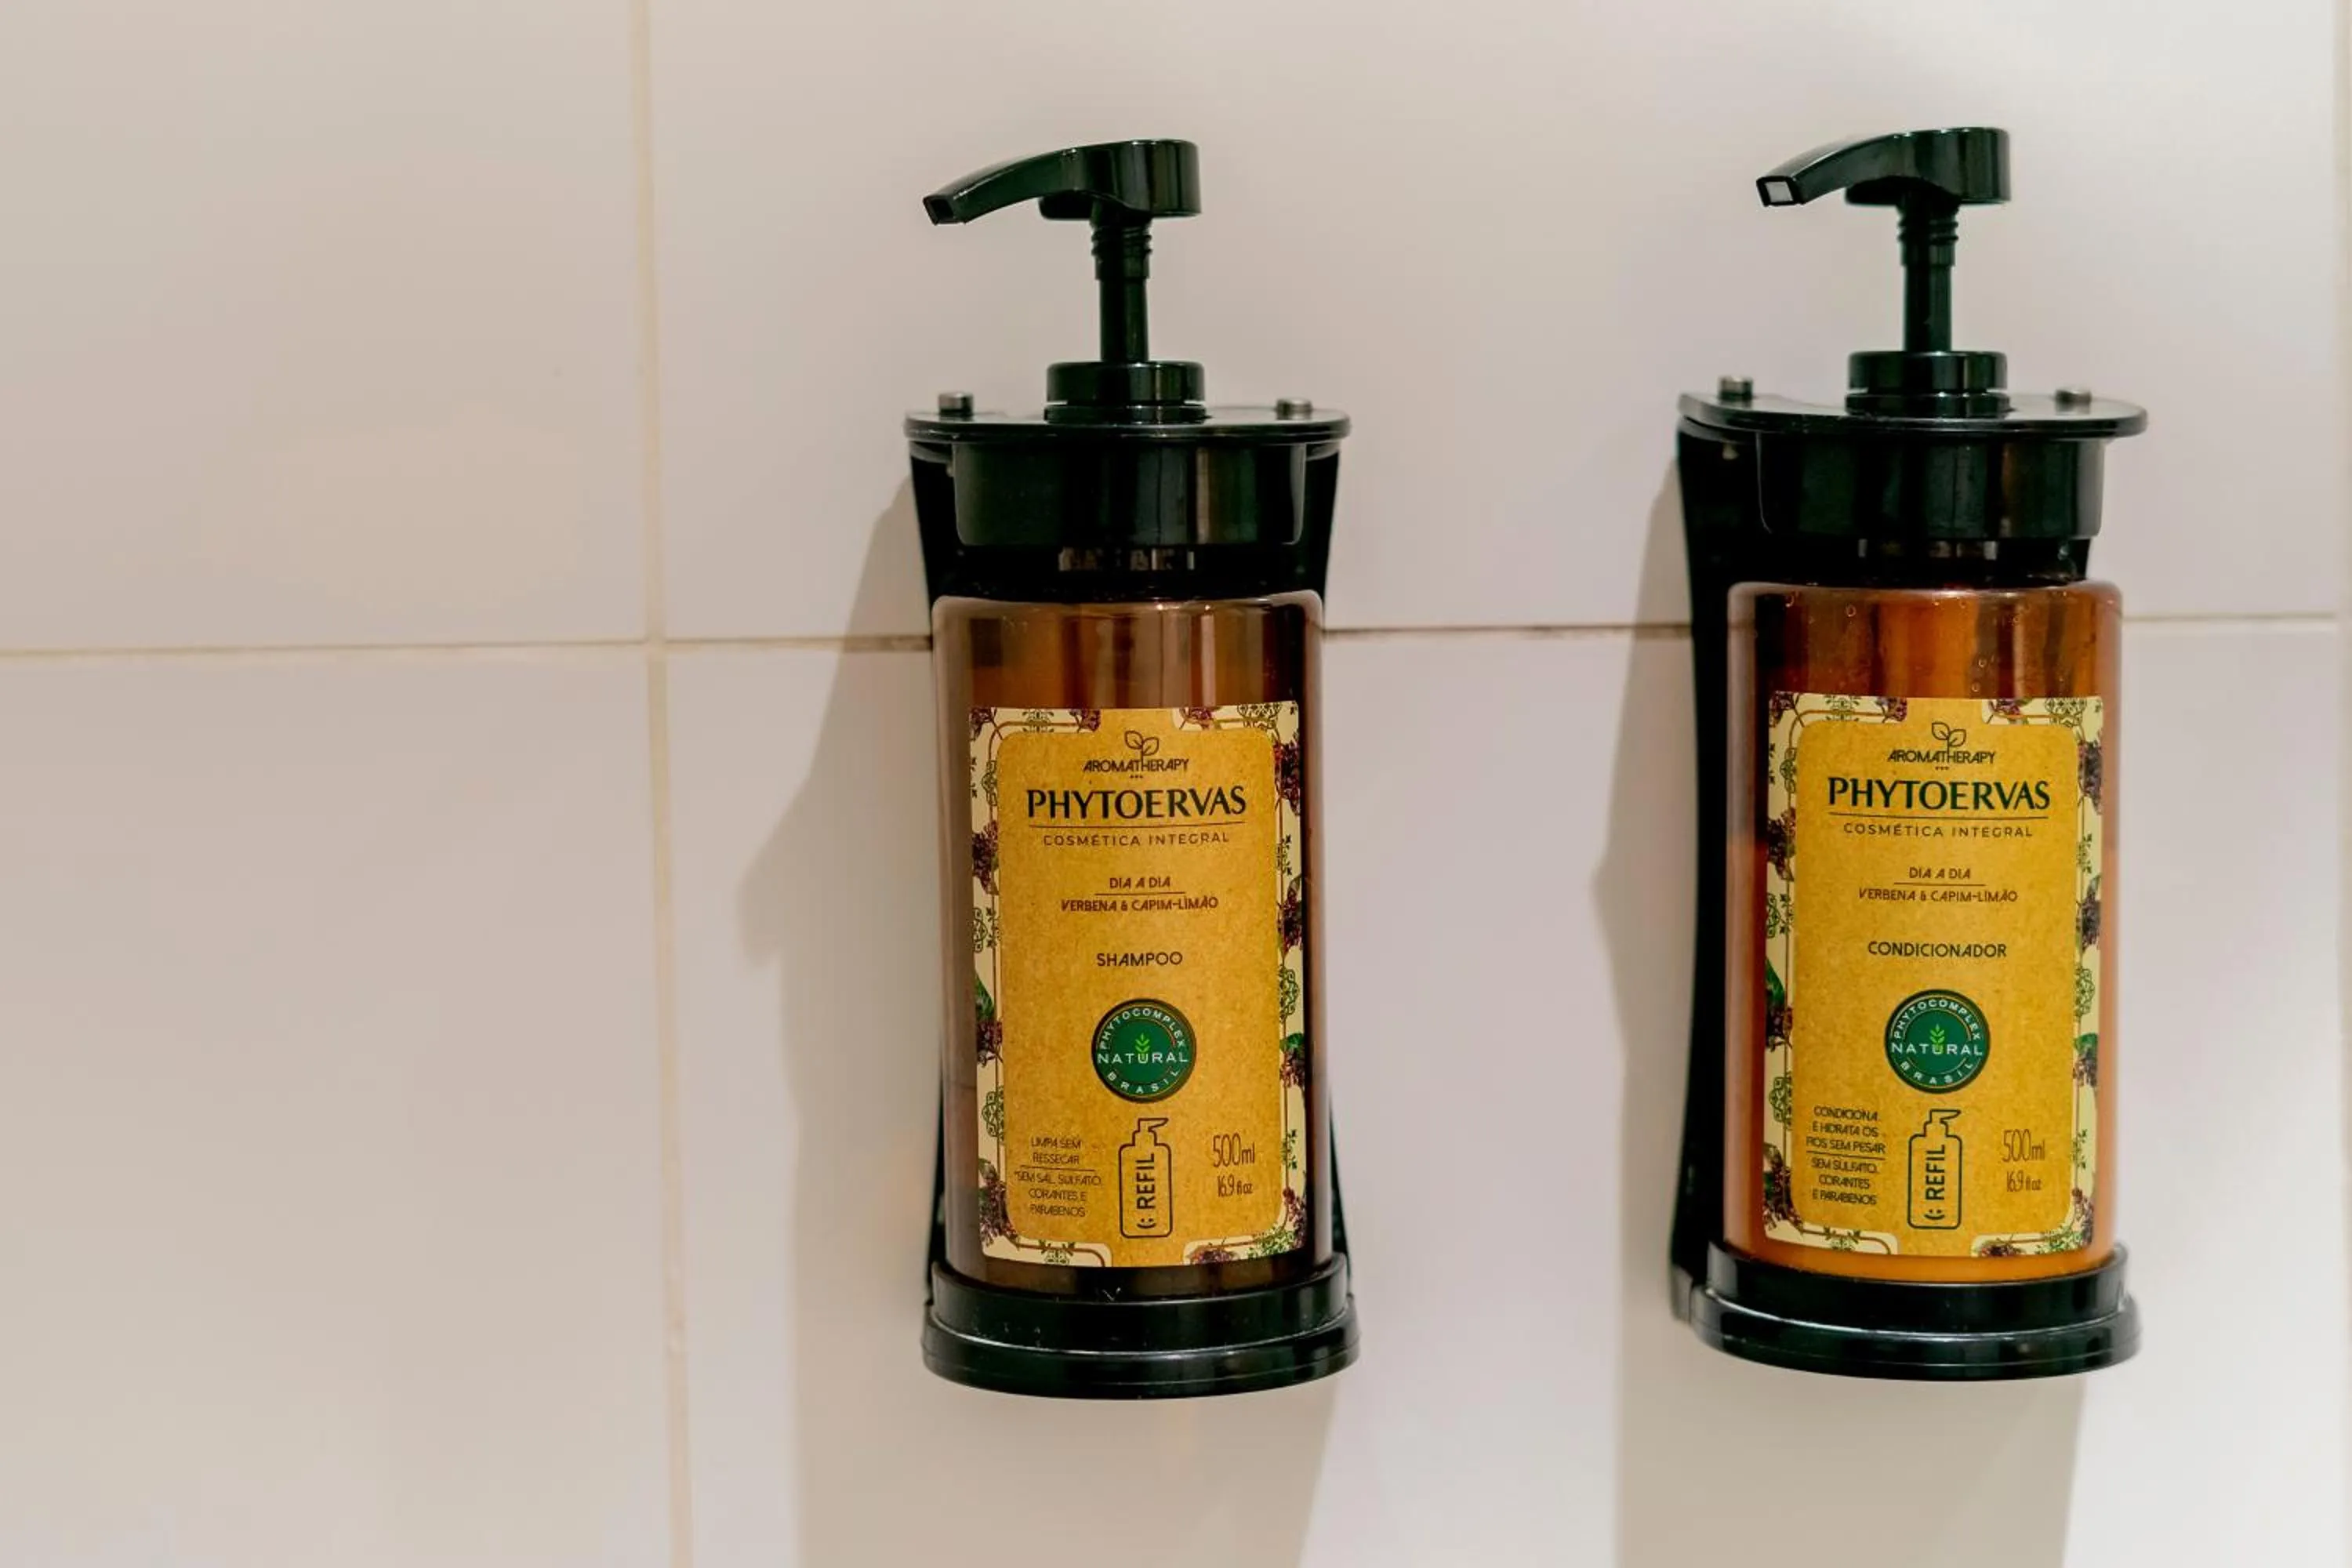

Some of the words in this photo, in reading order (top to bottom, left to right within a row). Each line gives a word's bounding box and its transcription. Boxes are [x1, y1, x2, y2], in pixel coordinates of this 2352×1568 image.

[1083, 758, 1189, 772] AROMATHERAPY
[1887, 750, 1996, 764] AROMATHERAPY
[1828, 777, 2051, 811] PHYTOERVAS
[1026, 786, 1247, 819] PHYTOERVAS
[1843, 822, 1944, 838] COSMÉTICA
[1951, 826, 2034, 839] INTEGRAL
[1044, 831, 1141, 847] COSMÉTICA
[1149, 832, 1230, 846] INTEGRAL
[1909, 867, 1932, 879] DIA
[1935, 868, 1945, 879] A
[1948, 868, 1971, 880] DIA
[1109, 877, 1131, 888] DIA
[1136, 877, 1145, 888] A
[1149, 876, 1171, 888] DIA
[1859, 887, 1915, 902] VERBENA
[1930, 889, 2018, 902] CAPIM-LIMÃO
[1061, 899, 1117, 912] VERBENA
[1868, 942, 2007, 957] CONDICIONADOR
[1097, 951, 1183, 967] SHAMPOO
[1893, 999, 1981, 1040] PHYTOCOMPLEX
[1099, 1007, 1186, 1050] PHYTOCOMPLEX
[1891, 1042, 1983, 1056] NATURAL
[1098, 1051, 1189, 1065] NATURAL
[1106, 1068, 1181, 1094] BRASIL
[1900, 1062, 1973, 1085] BRASIL
[1863, 1126, 1879, 1137] OS
[1213, 1133, 1255, 1167] 500ml
[1853, 1142, 1886, 1154] PESAR
[2002, 1129, 2045, 1163] 500ml
[1926, 1144, 1945, 1200] REFIL
[1135, 1152, 1156, 1210] REFIL
[1029, 1188, 1078, 1201] CORANTES
[1080, 1191, 1087, 1202] E
